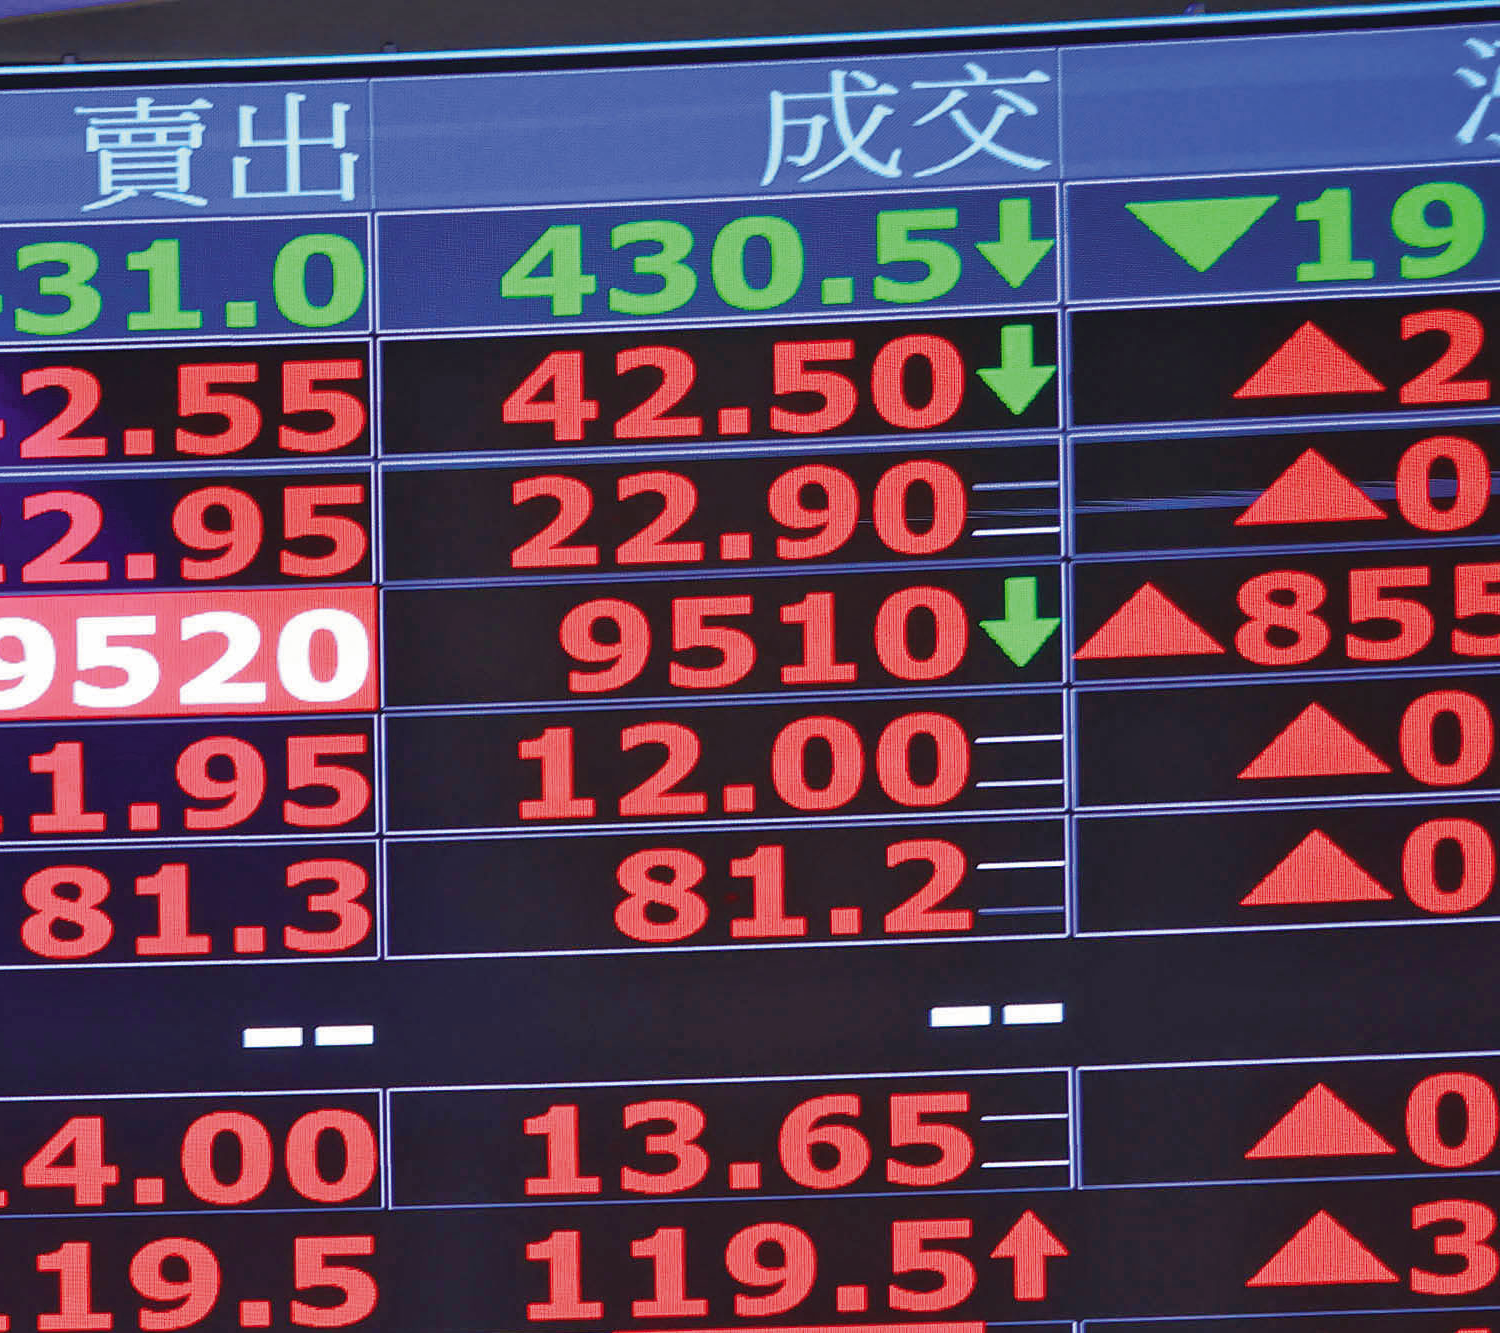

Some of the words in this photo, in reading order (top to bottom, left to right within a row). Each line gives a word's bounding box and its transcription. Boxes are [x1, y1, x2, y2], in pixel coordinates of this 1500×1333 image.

[75, 90, 361, 211] 賣出
[760, 66, 1052, 188] 成交
[499, 207, 962, 317] 430.5
[559, 585, 969, 693] 9510
[20, 858, 373, 960] 81.3
[614, 838, 973, 943] 81.2
